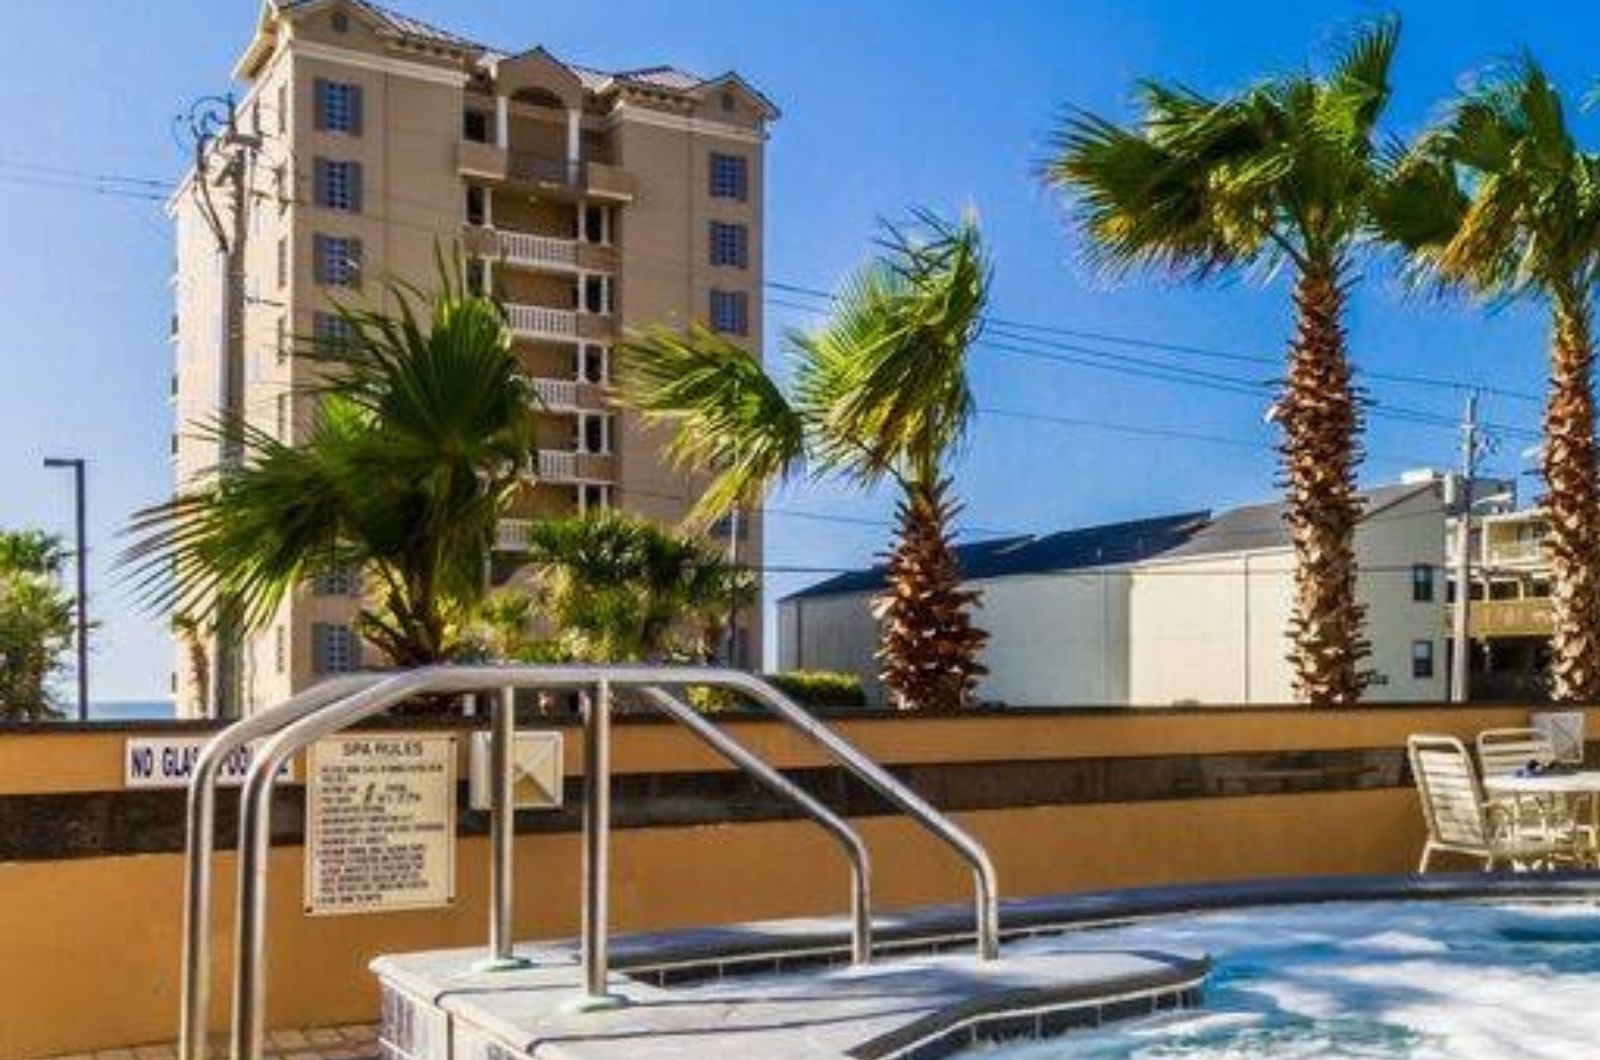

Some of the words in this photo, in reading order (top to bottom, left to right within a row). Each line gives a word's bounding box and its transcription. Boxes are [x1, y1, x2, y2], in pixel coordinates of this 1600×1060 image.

[343, 741, 370, 756] SPA
[375, 740, 422, 756] RULES
[131, 746, 153, 777] NO
[162, 746, 200, 777] GLAS
